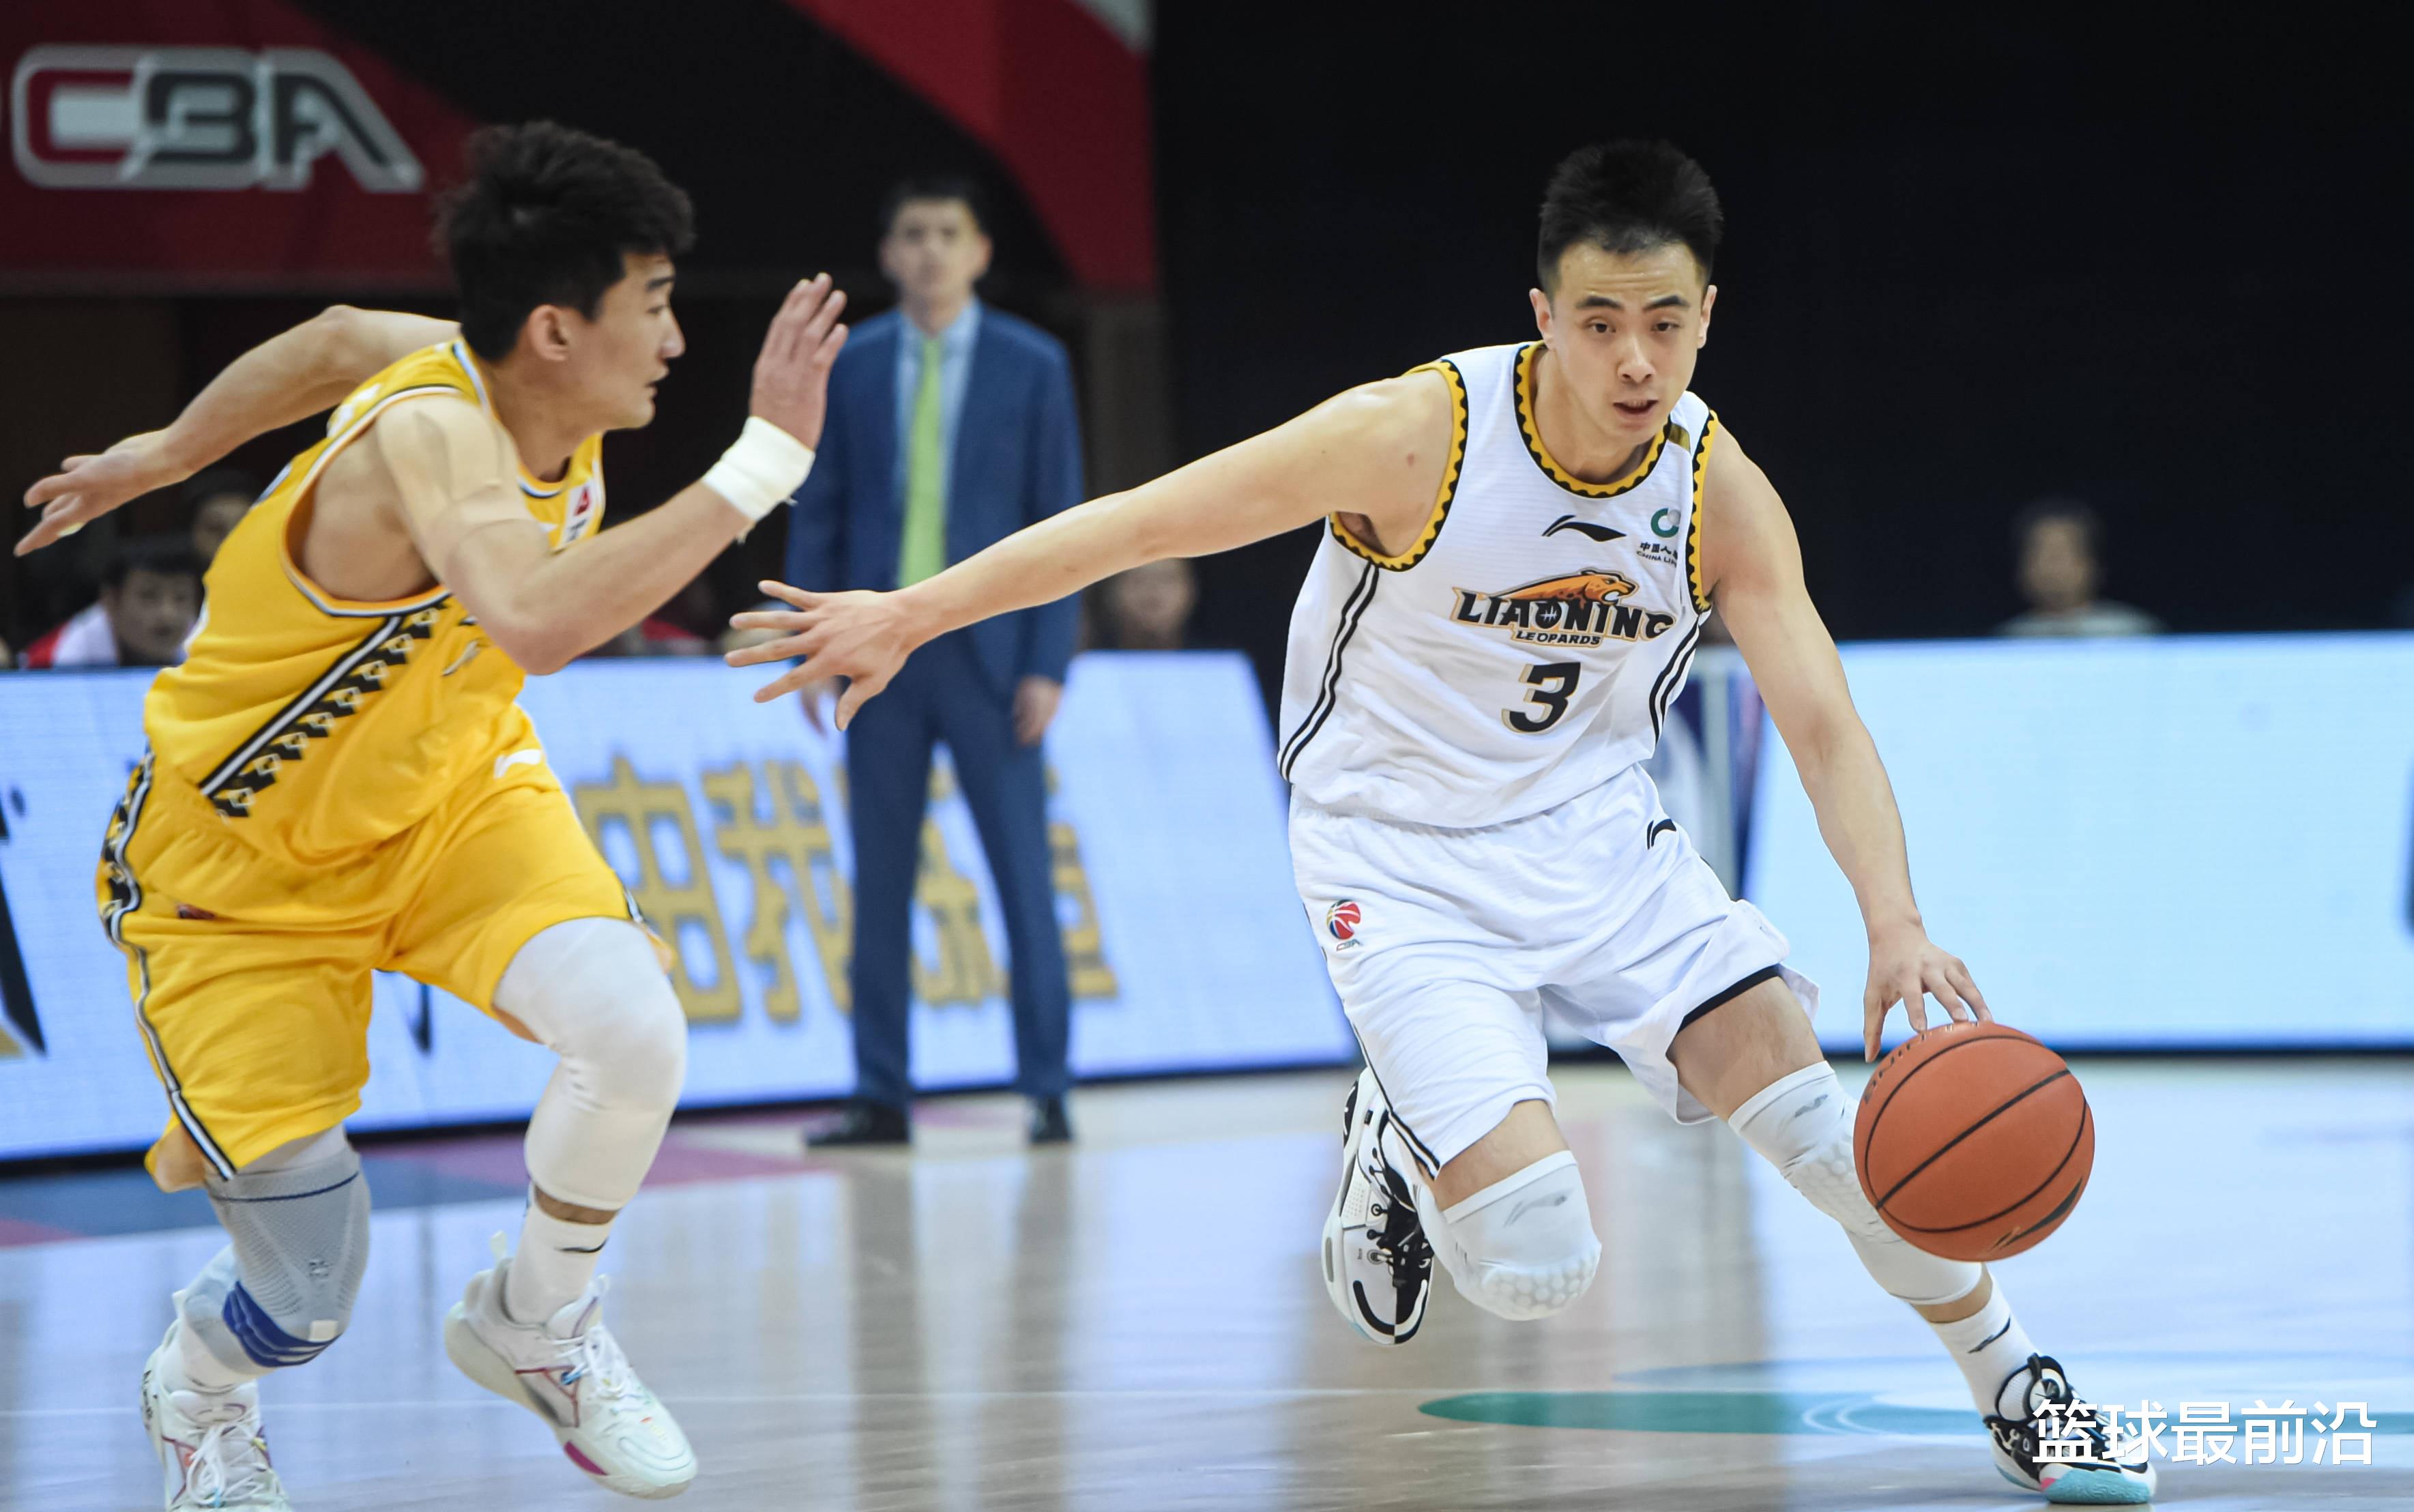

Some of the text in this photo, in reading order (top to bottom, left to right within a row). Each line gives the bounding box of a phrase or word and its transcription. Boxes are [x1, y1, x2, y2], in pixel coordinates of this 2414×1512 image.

[12, 44, 424, 192] CBA
[1636, 551, 1662, 562] CHINA
[1455, 590, 1676, 640] LIAONING
[1516, 630, 1601, 645] LEOPARDS
[1502, 662, 1581, 733] 3
